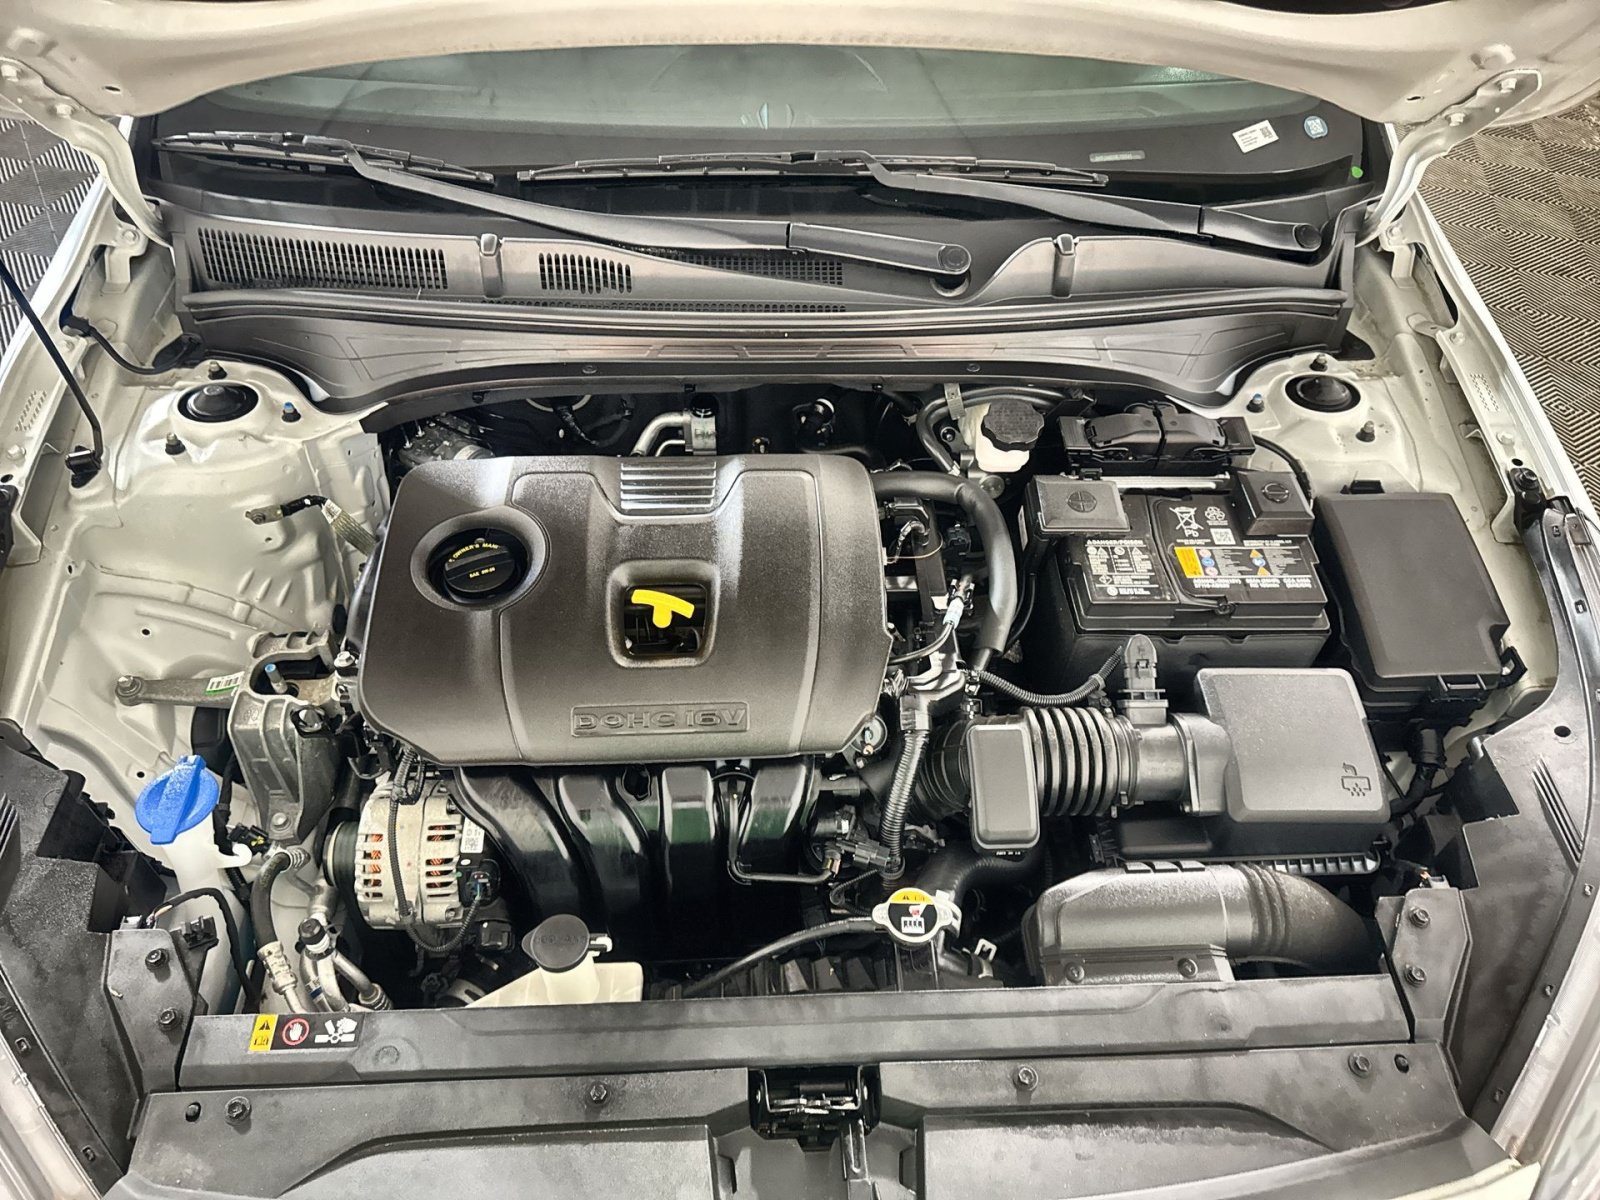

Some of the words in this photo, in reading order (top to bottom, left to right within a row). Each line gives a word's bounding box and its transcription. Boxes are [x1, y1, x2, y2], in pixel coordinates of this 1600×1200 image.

[1184, 529, 1199, 537] Pb
[573, 710, 677, 730] DOHC
[685, 708, 747, 727] 16V
